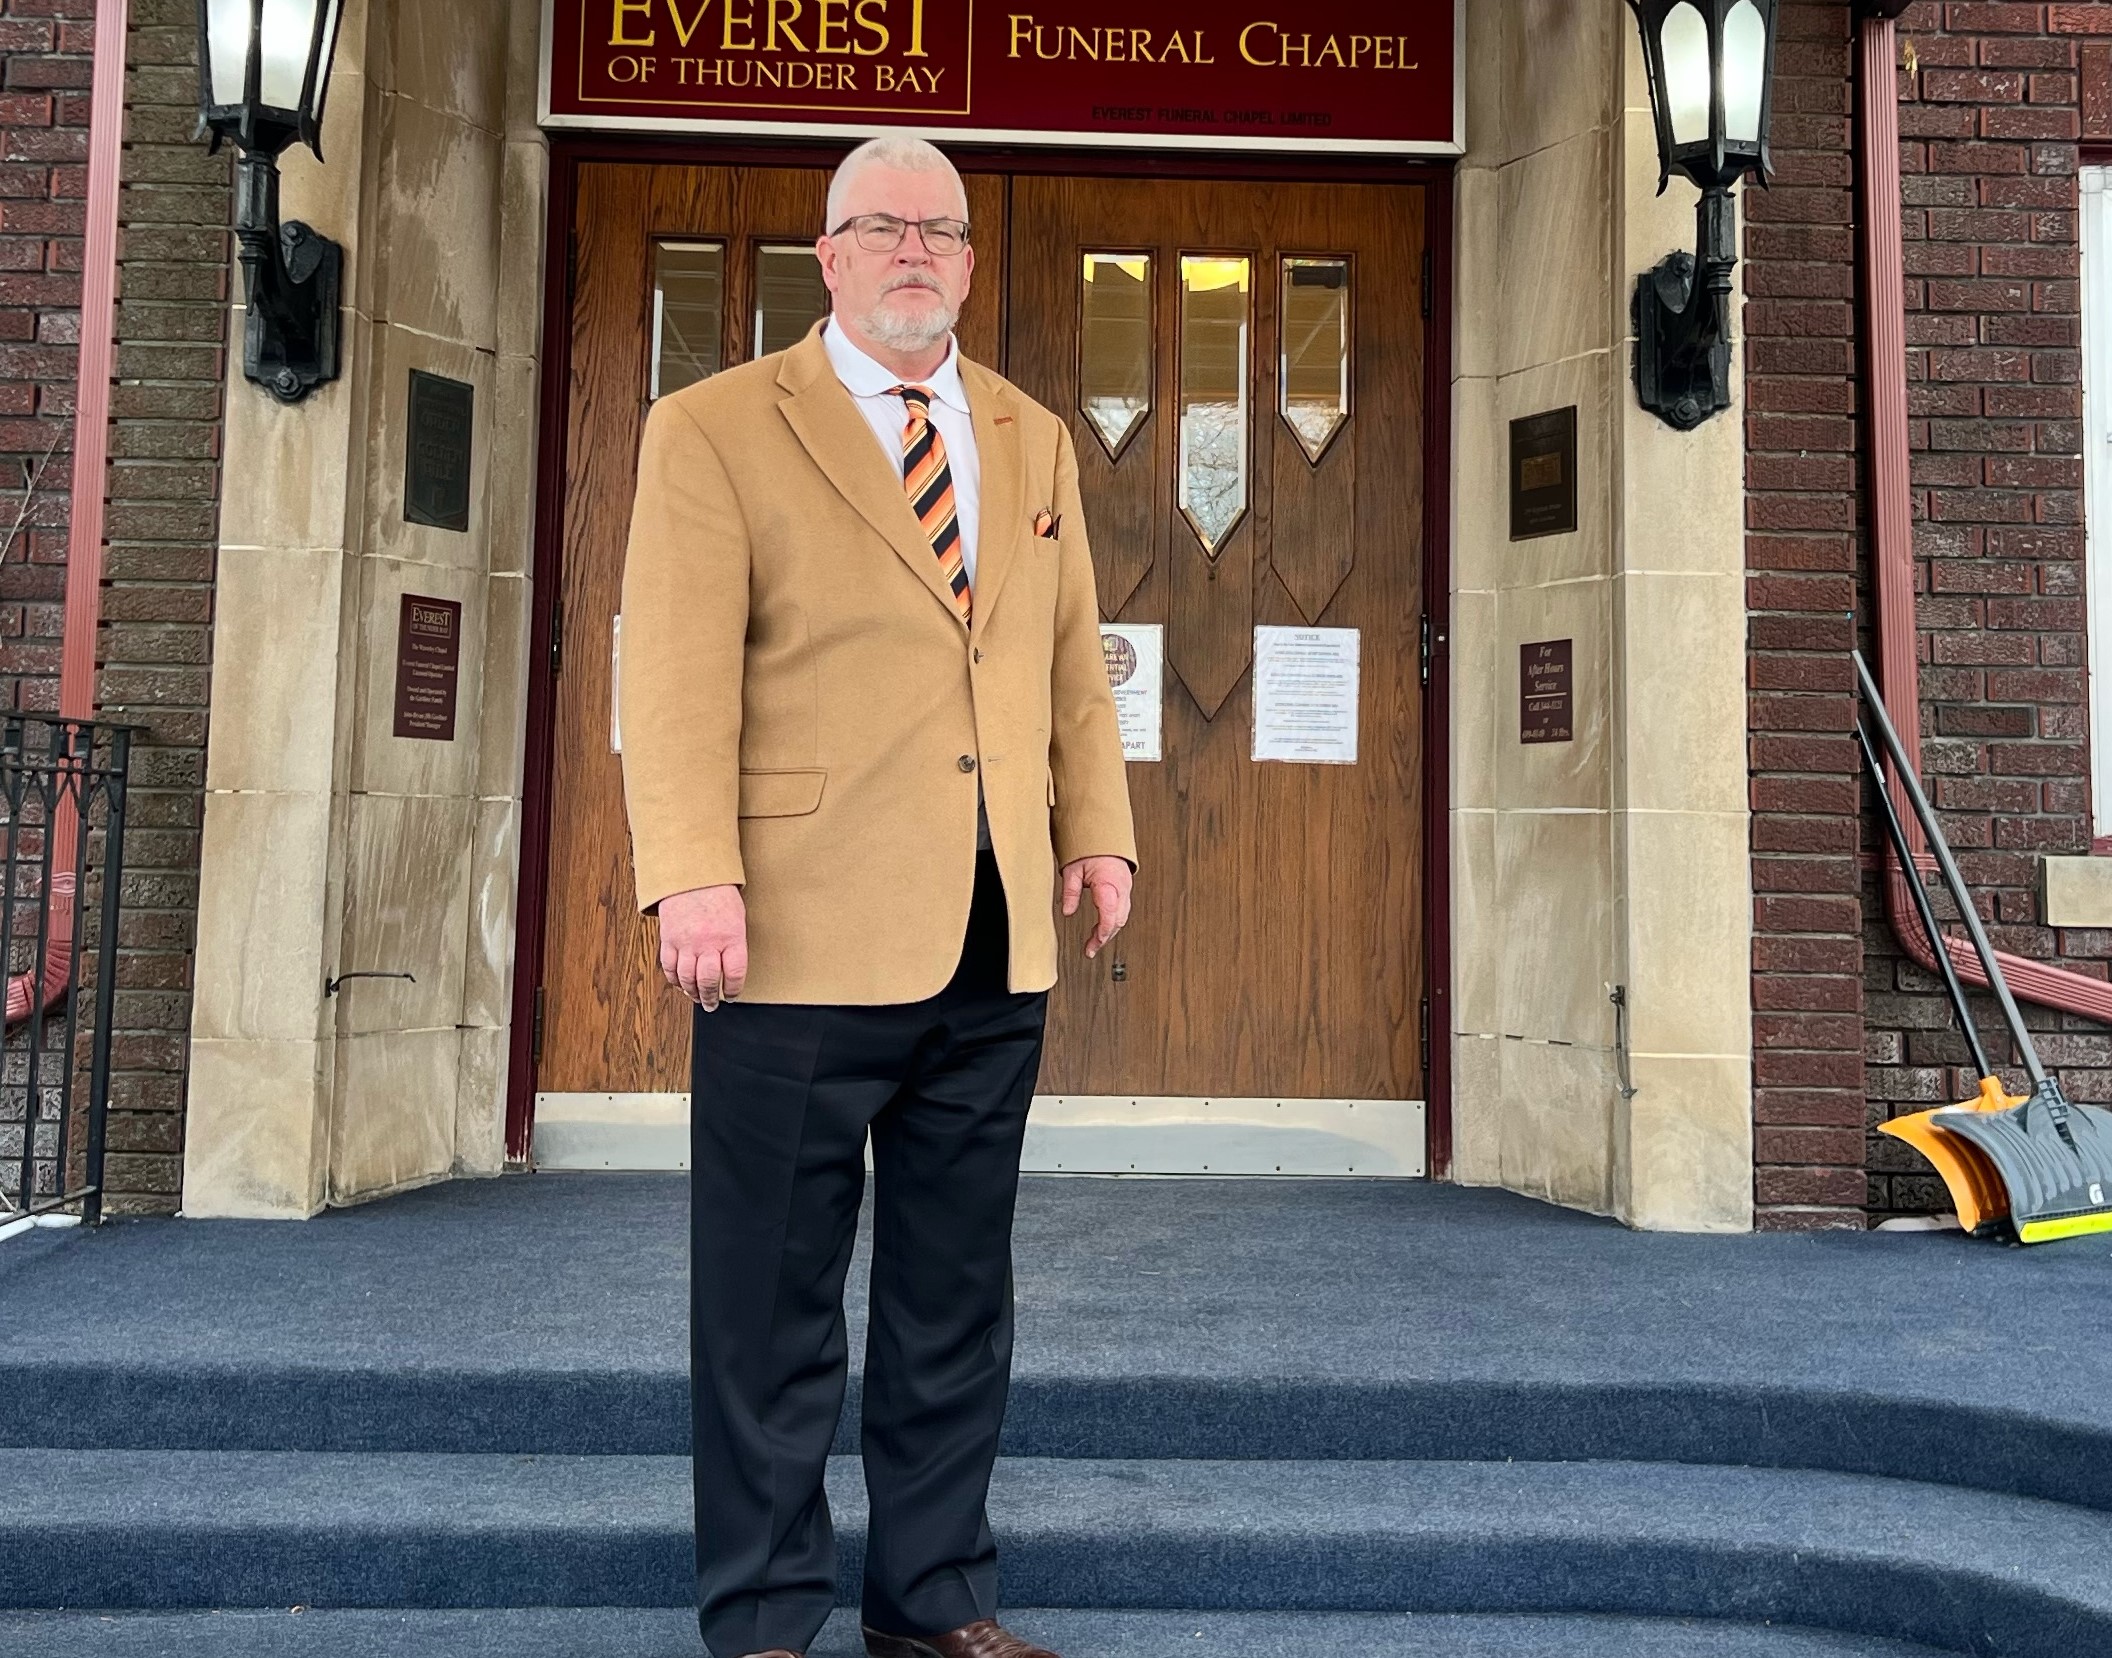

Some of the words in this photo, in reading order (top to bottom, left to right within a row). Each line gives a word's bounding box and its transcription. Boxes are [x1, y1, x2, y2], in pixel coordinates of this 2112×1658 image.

[1006, 13, 1215, 64] FUNERAL
[1238, 20, 1420, 70] CHAPEL
[607, 55, 657, 83] OF
[670, 57, 859, 91] THUNDER
[874, 64, 945, 93] BAY
[1091, 105, 1153, 122] EVEREST
[1157, 106, 1219, 124] FUNERAL
[1223, 110, 1275, 126] CHAPEL
[1280, 111, 1333, 128] LIMITED
[412, 606, 451, 627] EVEREST
[1539, 646, 1553, 658] For
[1528, 664, 1543, 678] After
[1544, 662, 1564, 675] Hours
[1534, 679, 1558, 692] Service
